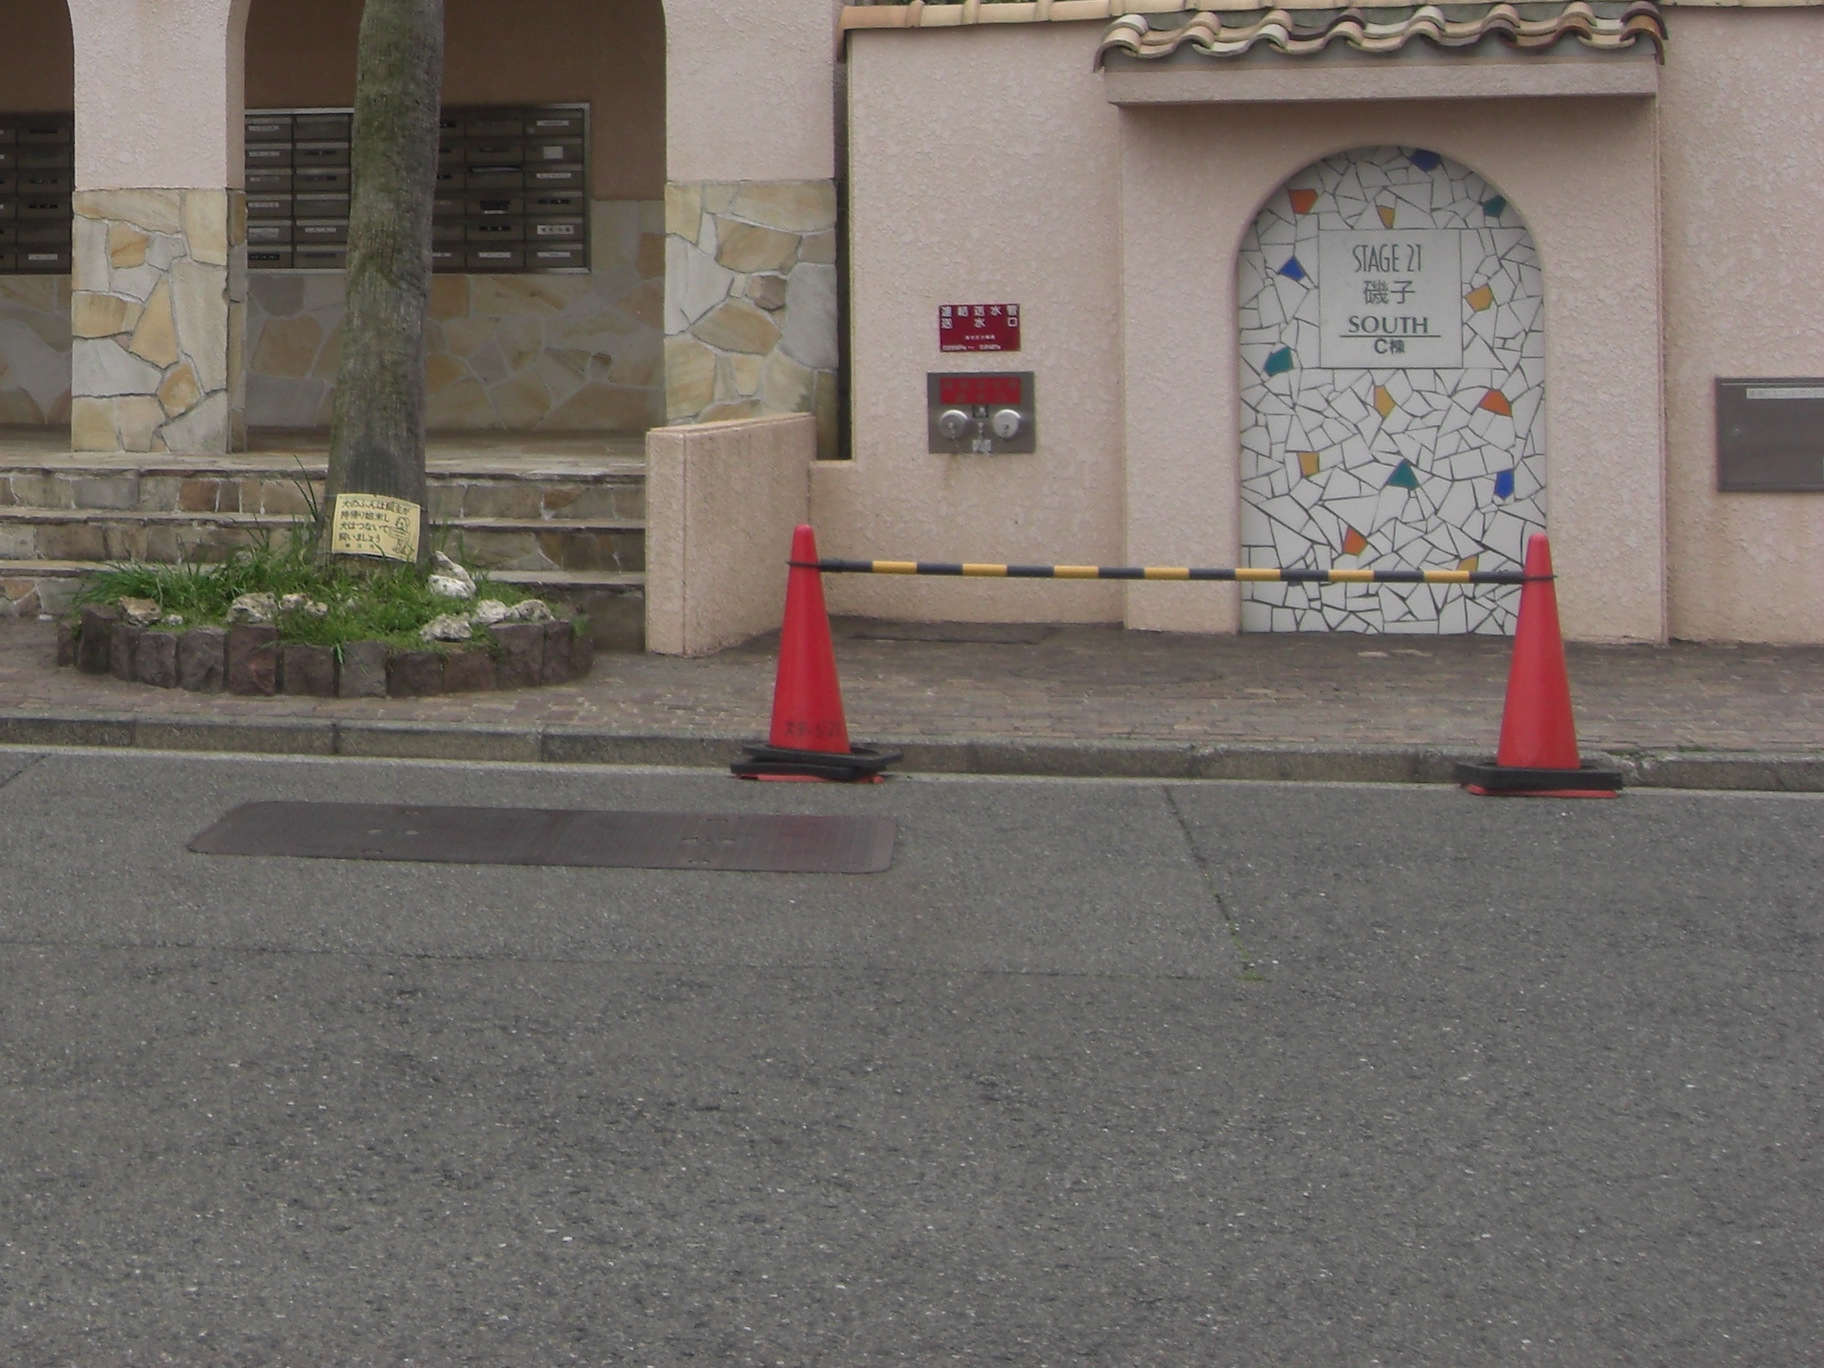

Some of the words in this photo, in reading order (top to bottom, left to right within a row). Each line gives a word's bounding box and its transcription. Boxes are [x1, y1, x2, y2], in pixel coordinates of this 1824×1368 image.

[1352, 244, 1400, 273] STAGE
[1406, 244, 1422, 273] 21
[1363, 280, 1416, 305] 磯子
[1348, 315, 1429, 334] SOUTH
[1374, 337, 1406, 354] C棟
